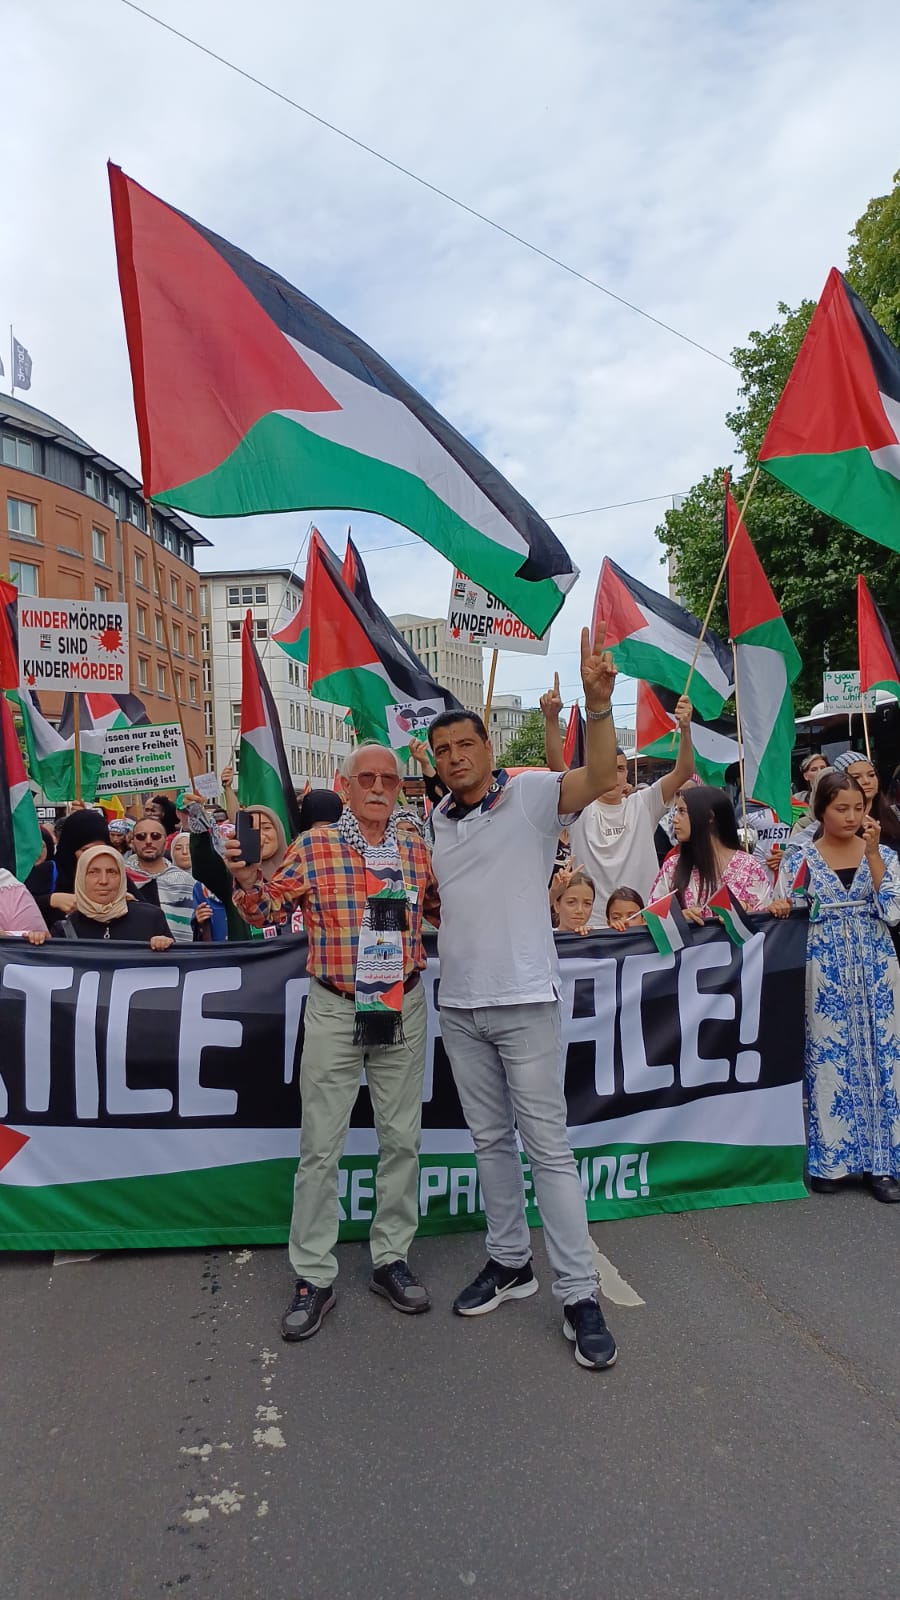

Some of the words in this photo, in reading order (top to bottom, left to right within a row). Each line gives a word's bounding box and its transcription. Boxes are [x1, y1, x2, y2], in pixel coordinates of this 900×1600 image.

[486, 592, 508, 611] SI
[22, 607, 123, 631] KINDERMÖRDER
[449, 611, 544, 641] KINDERMÖRD
[58, 636, 88, 655] SIND
[23, 656, 124, 681] KINDERMÖRDER
[834, 672, 856, 684] your
[105, 733, 130, 742] issen
[132, 732, 147, 740] nur
[149, 730, 161, 738] zu
[162, 727, 181, 739] gut,
[108, 744, 140, 754] unsere
[142, 738, 178, 750] Freiheit
[118, 755, 133, 765] die
[135, 750, 172, 762] Freiheit
[111, 764, 176, 777] Palästinenser
[160, 773, 177, 784] ist!
[0, 963, 244, 1120] TICE
